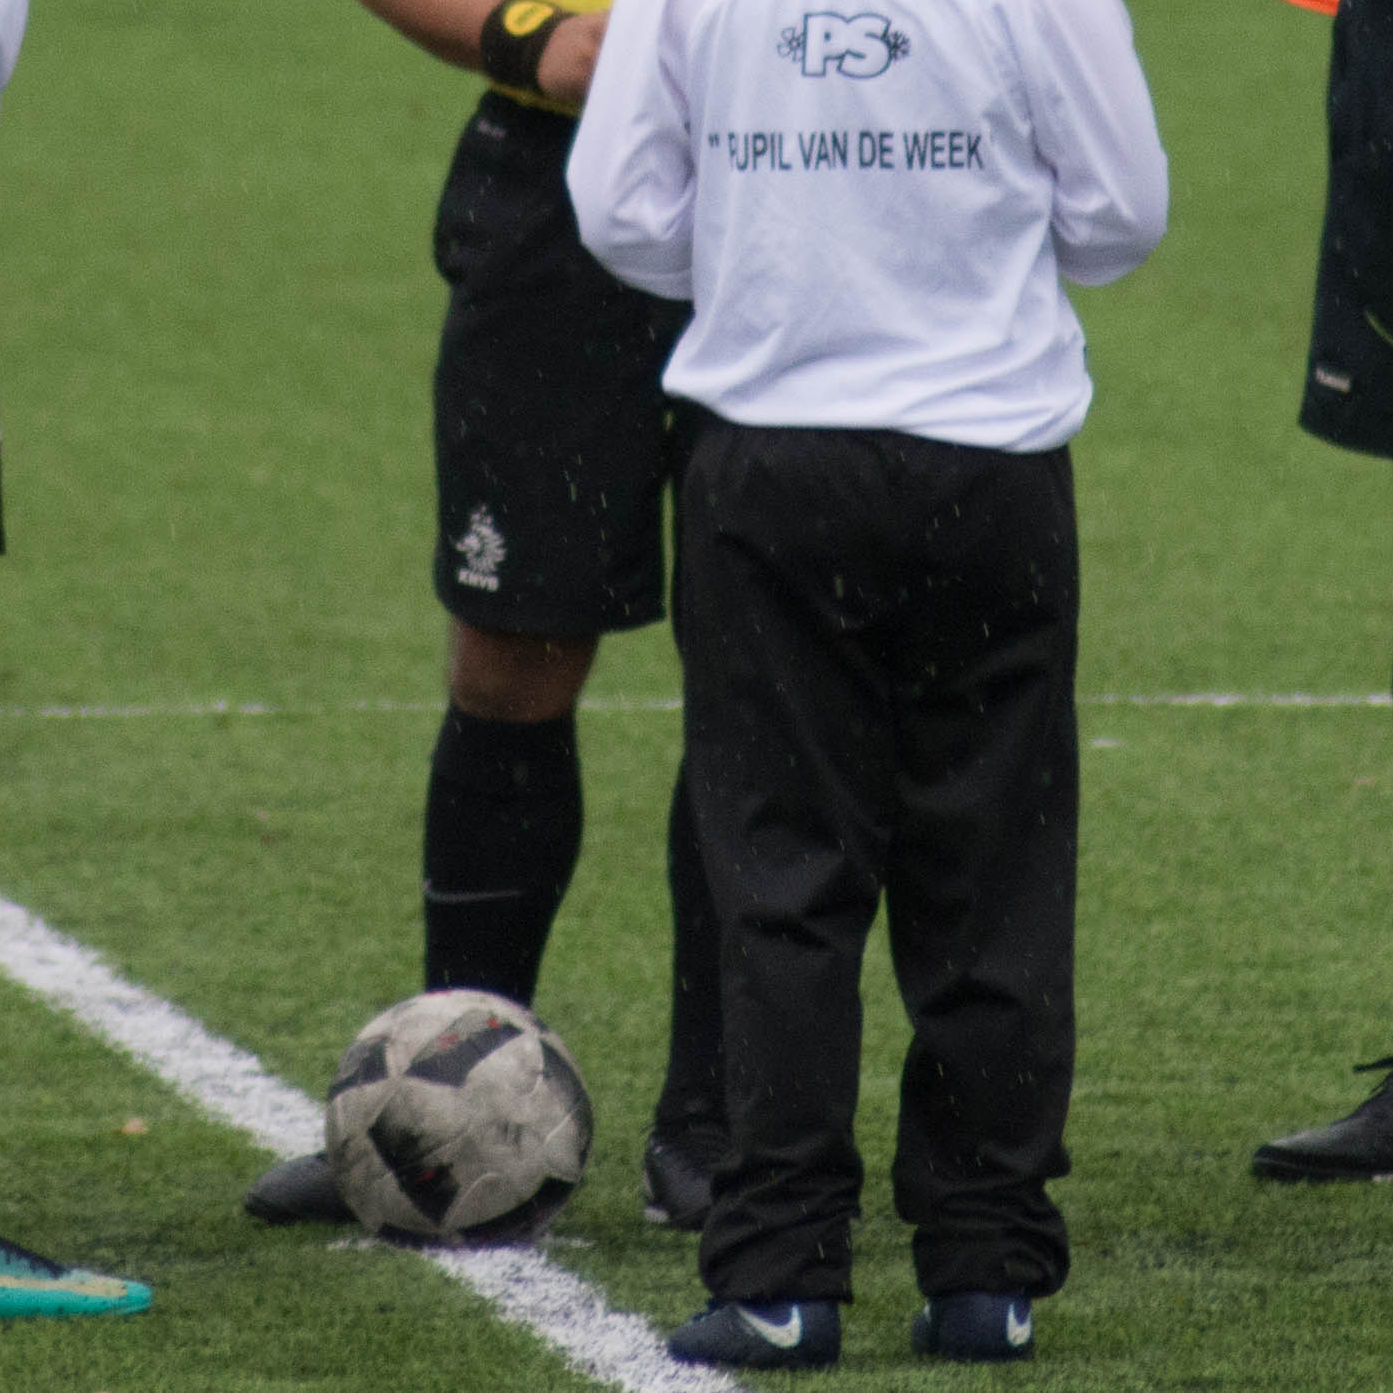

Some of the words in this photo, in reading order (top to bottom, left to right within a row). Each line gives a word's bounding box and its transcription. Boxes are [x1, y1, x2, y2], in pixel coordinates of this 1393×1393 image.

[802, 11, 892, 80] PS
[797, 129, 849, 171] VAN
[858, 130, 895, 170] DE
[903, 129, 986, 172] WEEK
